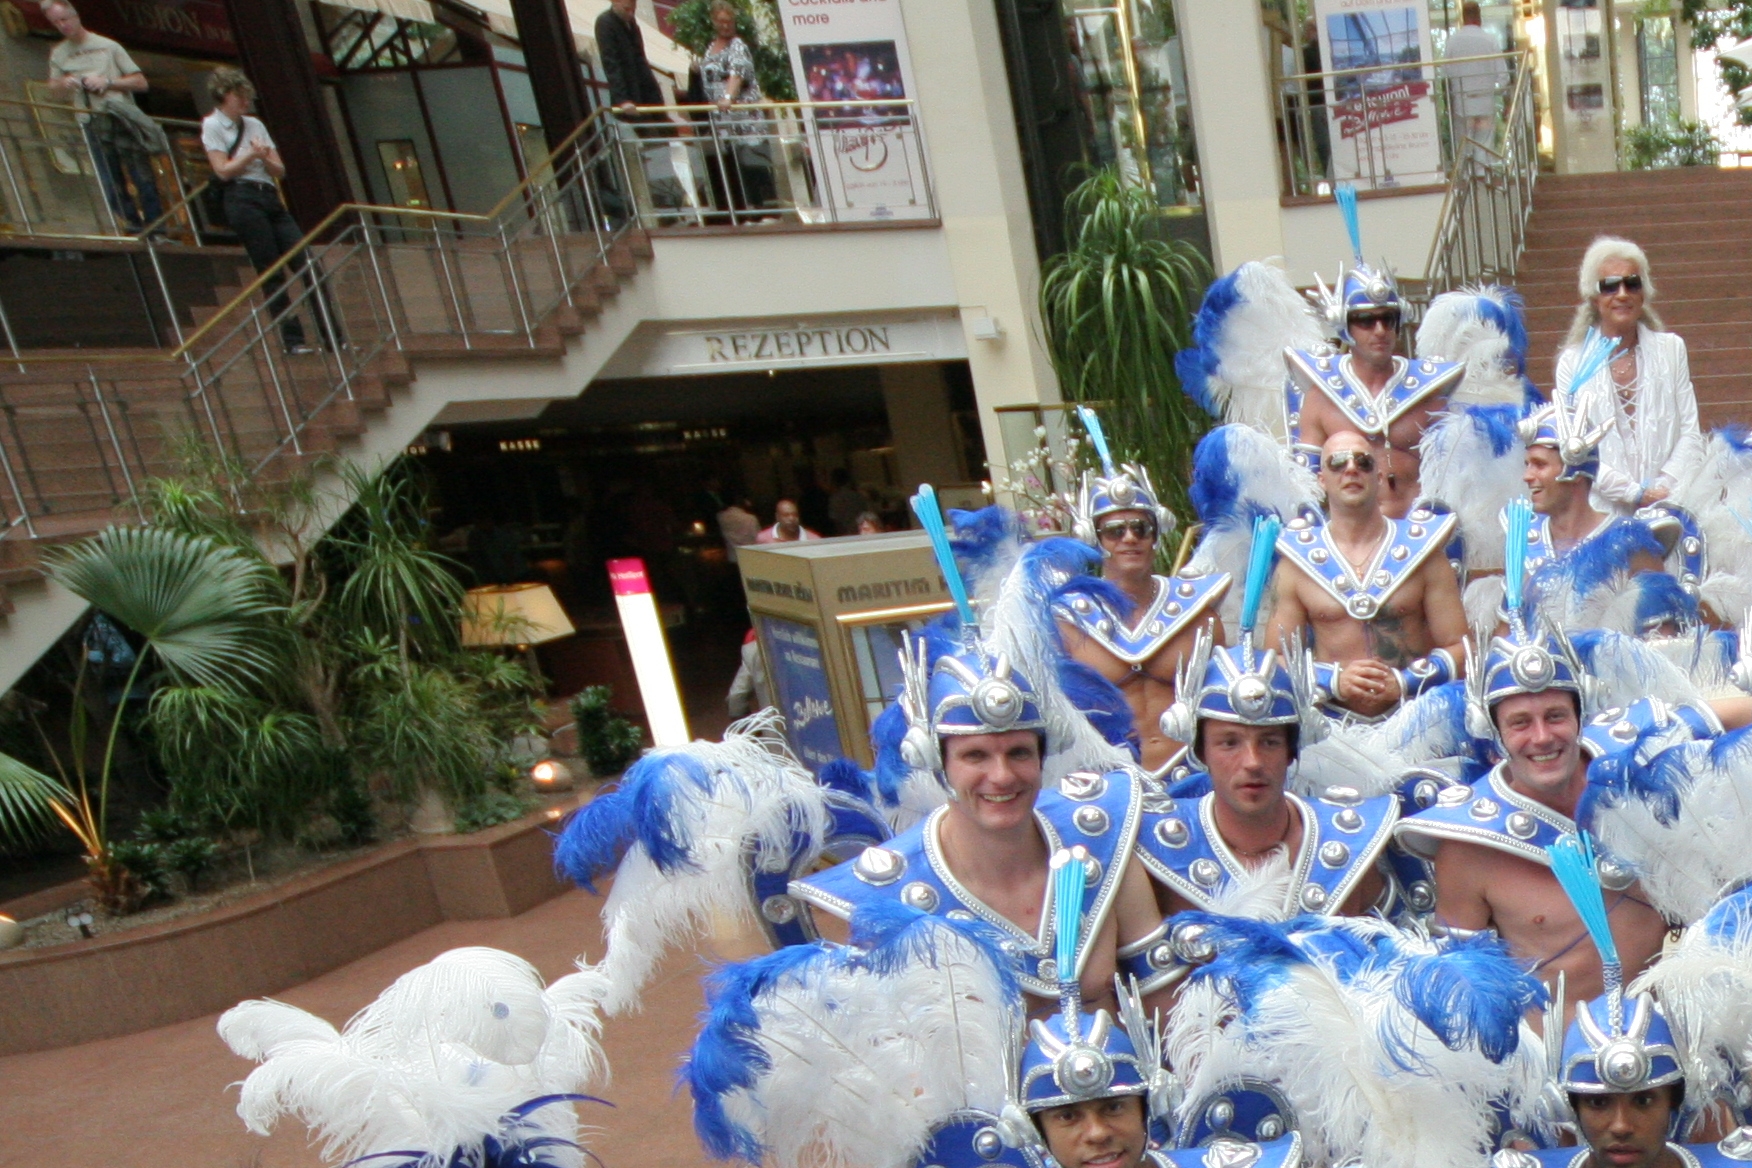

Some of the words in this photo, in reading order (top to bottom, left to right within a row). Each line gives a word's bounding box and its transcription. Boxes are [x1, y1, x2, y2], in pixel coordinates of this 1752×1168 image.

[792, 13, 830, 25] more
[705, 327, 891, 362] REZEPTION
[837, 576, 930, 604] MARITIM
